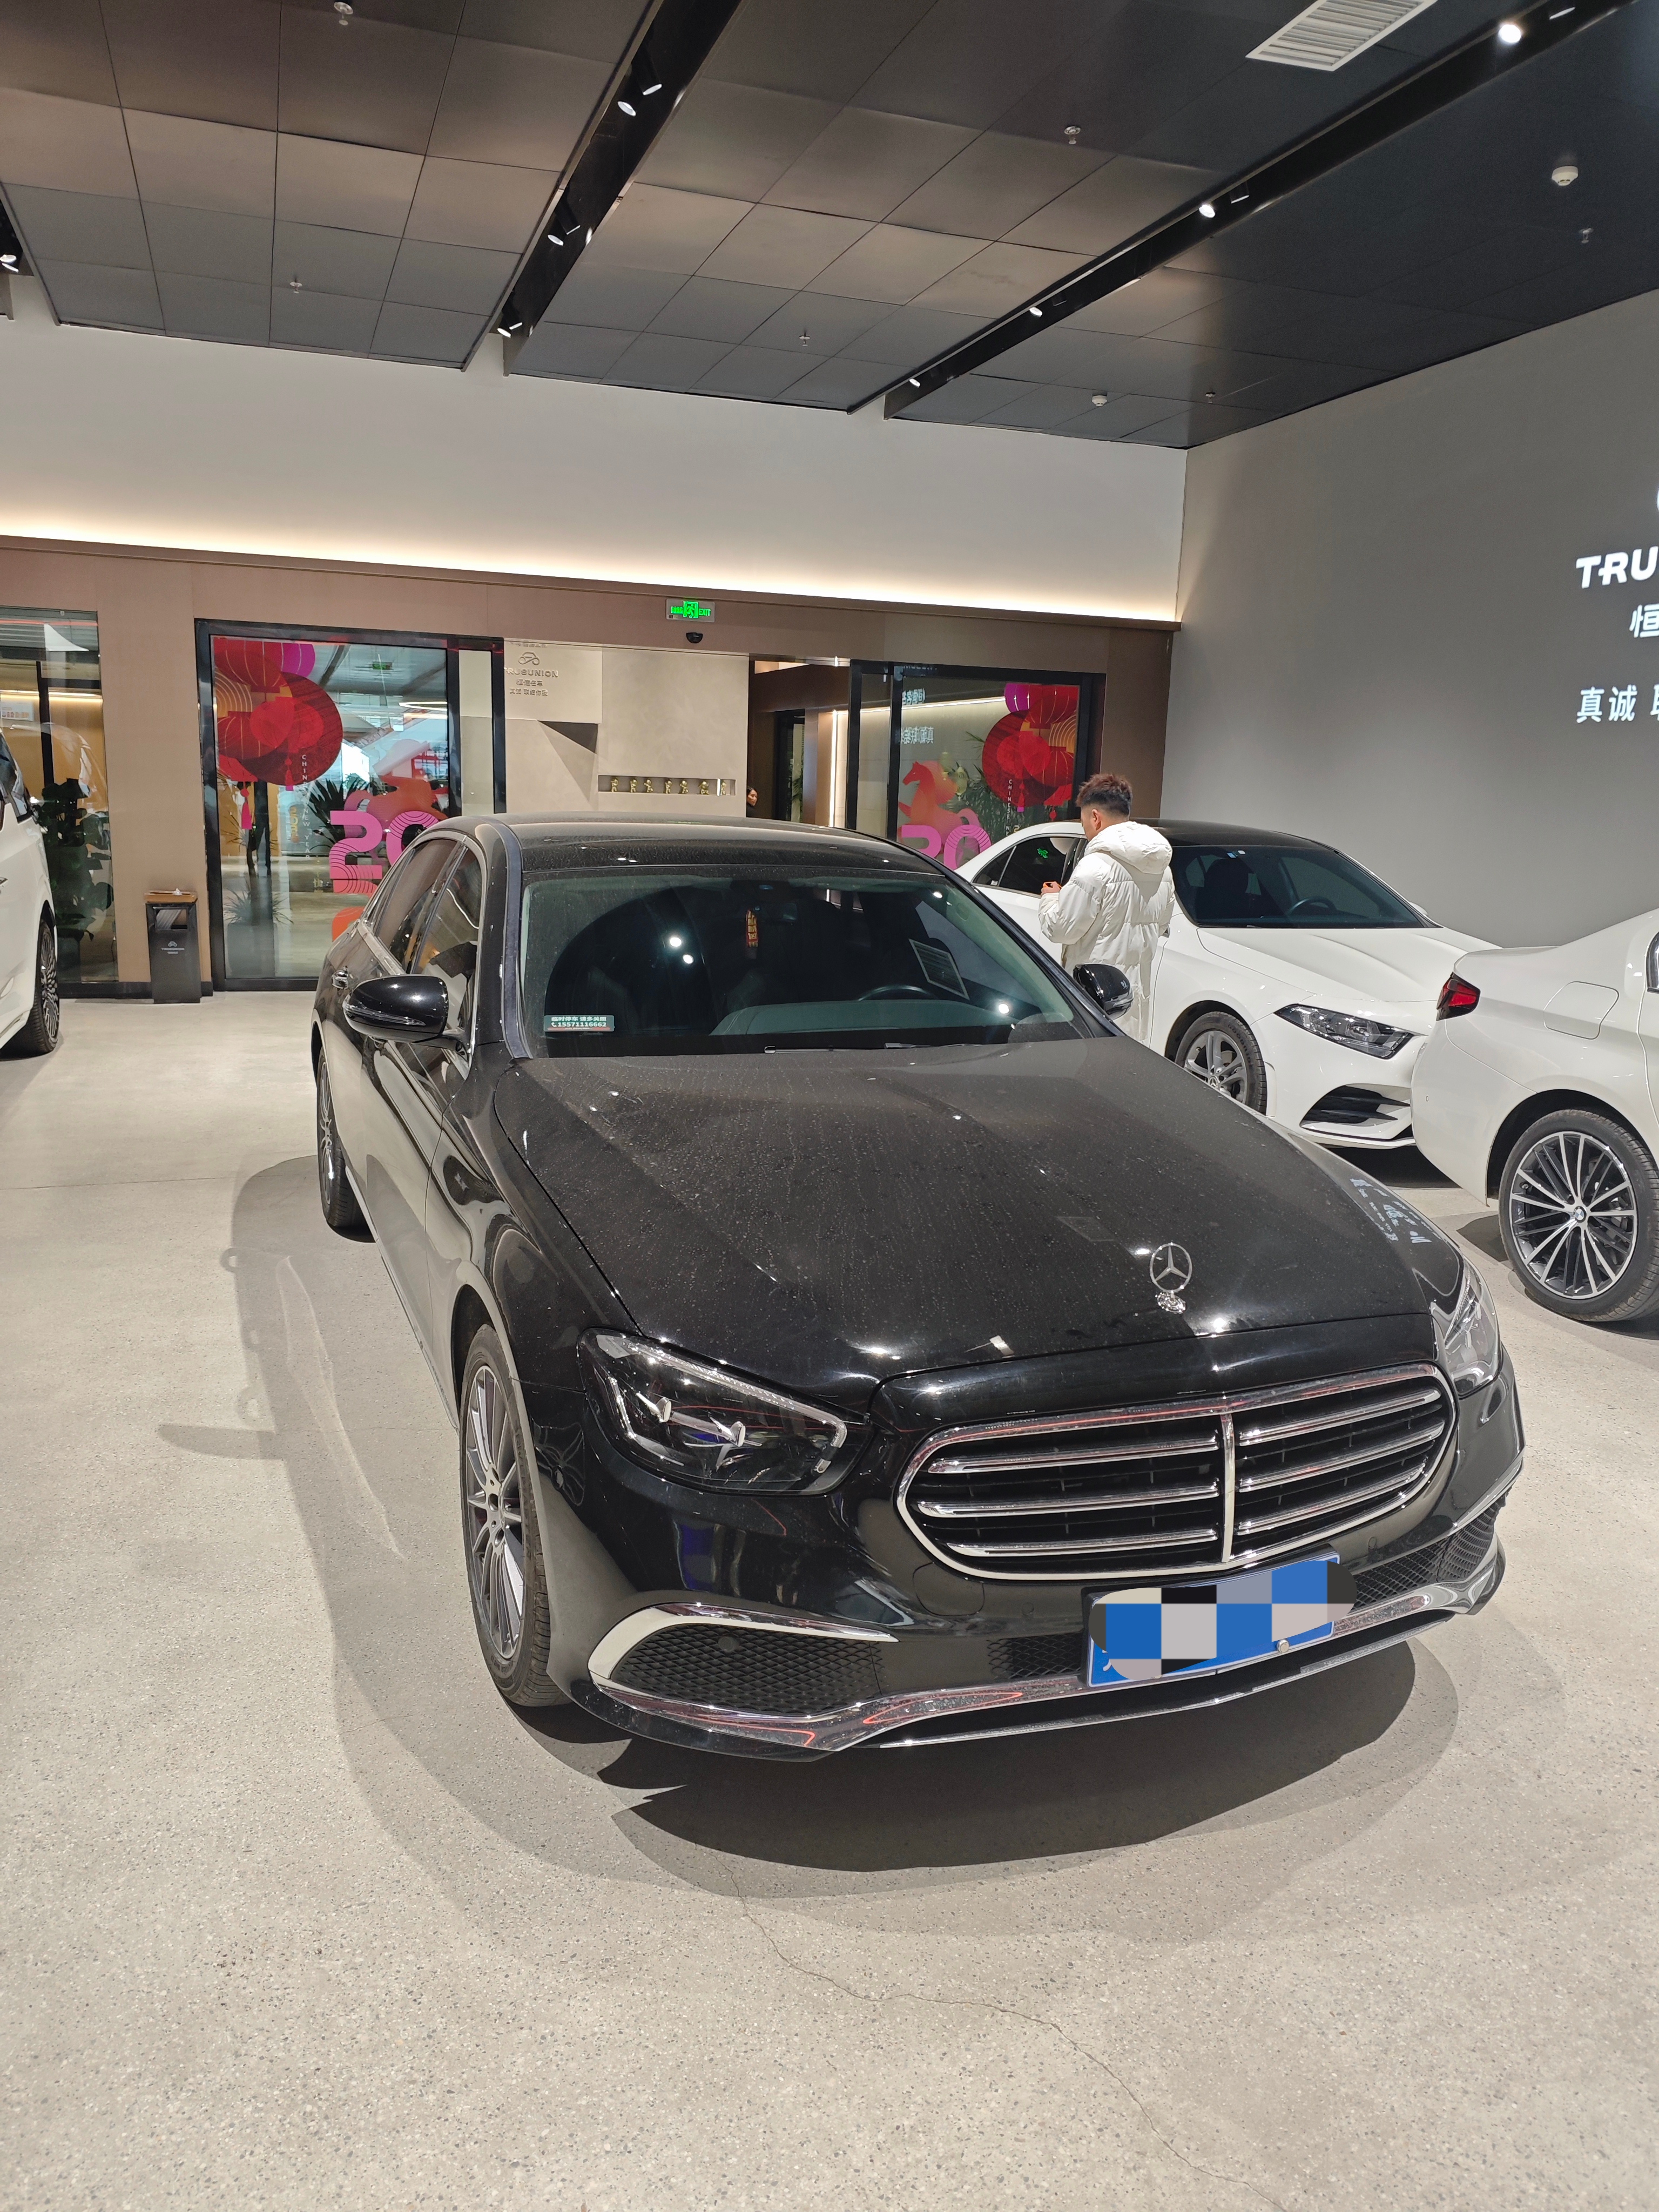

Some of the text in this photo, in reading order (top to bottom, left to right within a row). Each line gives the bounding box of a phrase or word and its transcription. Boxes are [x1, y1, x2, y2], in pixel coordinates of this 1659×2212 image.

[503, 667, 559, 678] RUSUNION
[1576, 684, 1638, 723] 真诚
[302, 808, 311, 827] NEW
